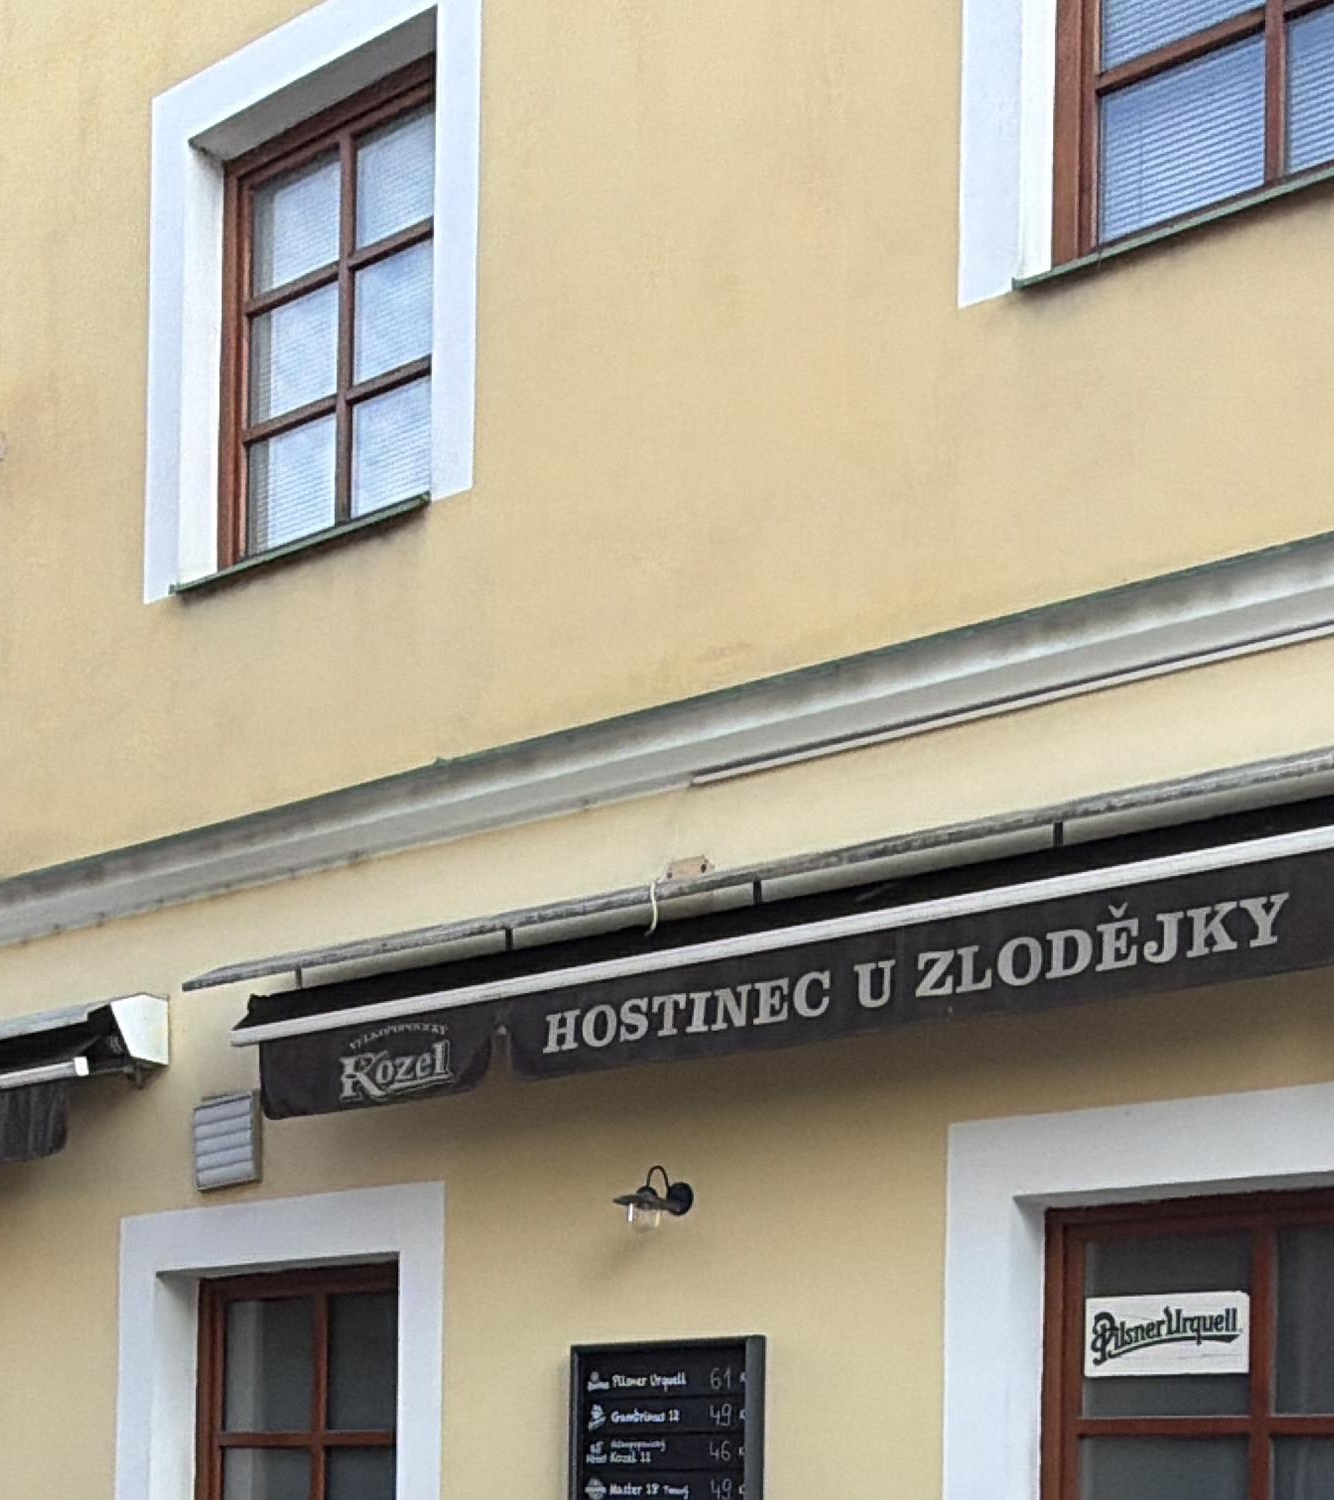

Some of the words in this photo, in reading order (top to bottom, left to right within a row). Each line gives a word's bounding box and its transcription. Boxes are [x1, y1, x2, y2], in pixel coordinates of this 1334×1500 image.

[543, 970, 831, 1054] HOSTINEC
[853, 960, 892, 1008] U
[915, 892, 1289, 998] ZLODĚJKY
[339, 1039, 455, 1102] Kozel
[1091, 1312, 1167, 1366] Pilsner
[1163, 1306, 1238, 1346] Urquell
[709, 1365, 732, 1390] 61
[709, 1403, 732, 1427] 49
[709, 1440, 732, 1462] 46
[710, 1478, 733, 1500] 49
